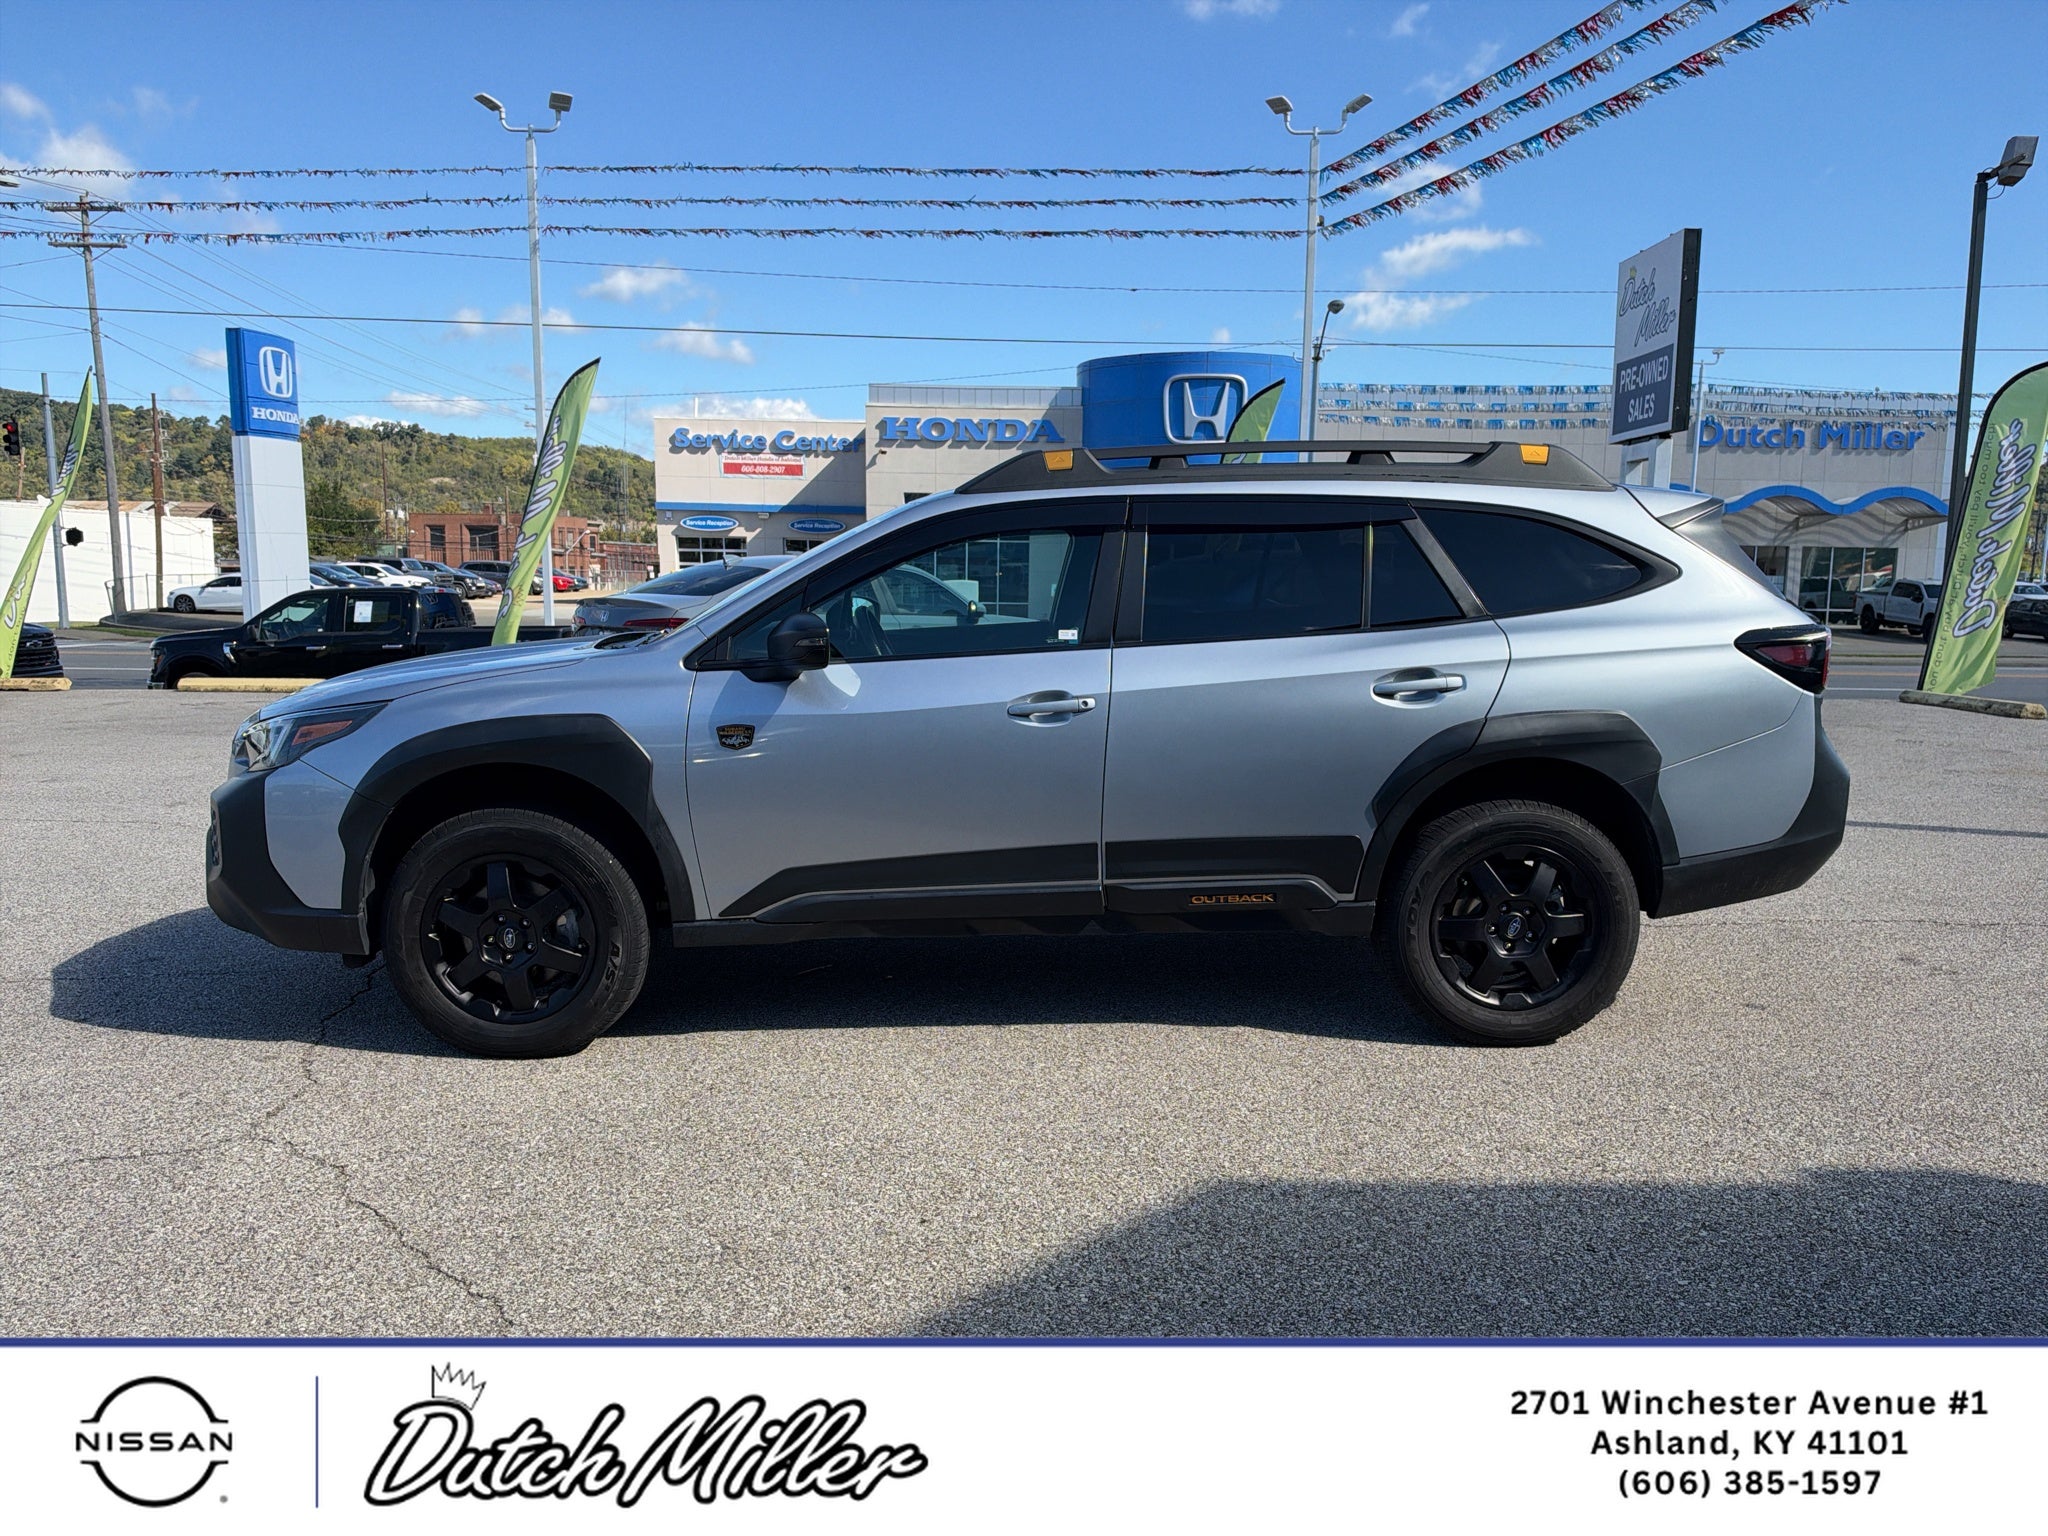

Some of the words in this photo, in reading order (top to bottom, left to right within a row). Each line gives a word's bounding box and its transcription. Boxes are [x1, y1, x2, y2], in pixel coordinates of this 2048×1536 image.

[1618, 267, 1656, 317] Dutch
[1634, 296, 1677, 347] Miller
[1619, 355, 1669, 394] PRE-OWNED
[251, 407, 299, 424] HONDA
[1628, 392, 1656, 423] SALES
[673, 427, 768, 453] Service
[775, 429, 865, 454] Center
[882, 416, 1066, 443] HONDA
[1700, 419, 1805, 449] Dutch
[1819, 419, 1926, 450] Miller
[1191, 893, 1274, 904] OUTBACK
